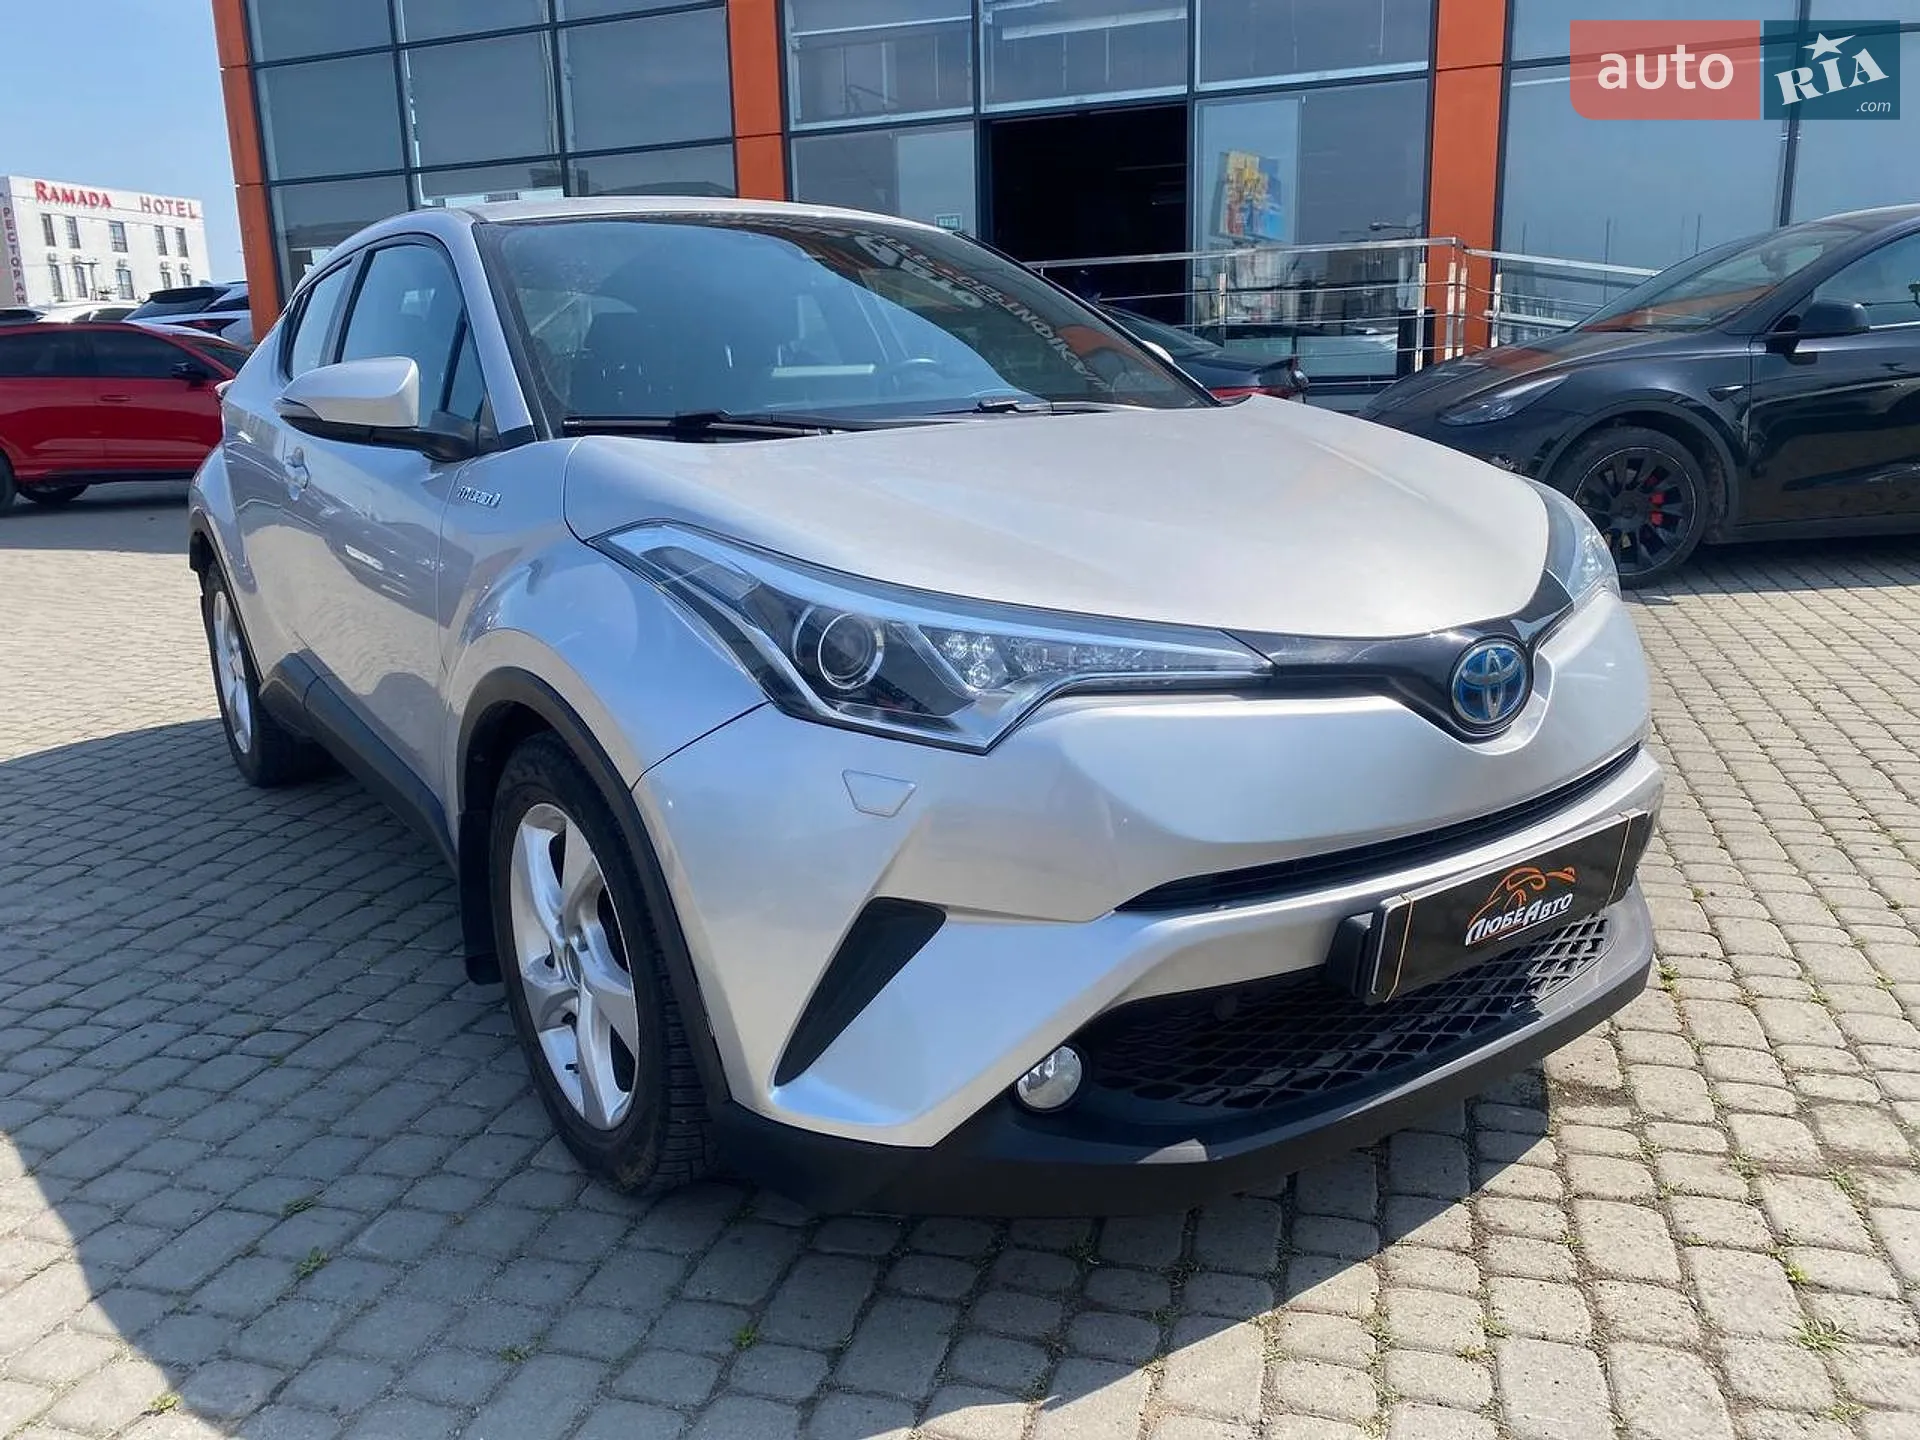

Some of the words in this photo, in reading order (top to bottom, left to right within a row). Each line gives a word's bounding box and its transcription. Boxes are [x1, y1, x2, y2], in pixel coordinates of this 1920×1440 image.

[34, 180, 112, 209] RAMADA
[140, 195, 198, 219] HOTEL
[3, 206, 26, 305] РЕСТОРАН
